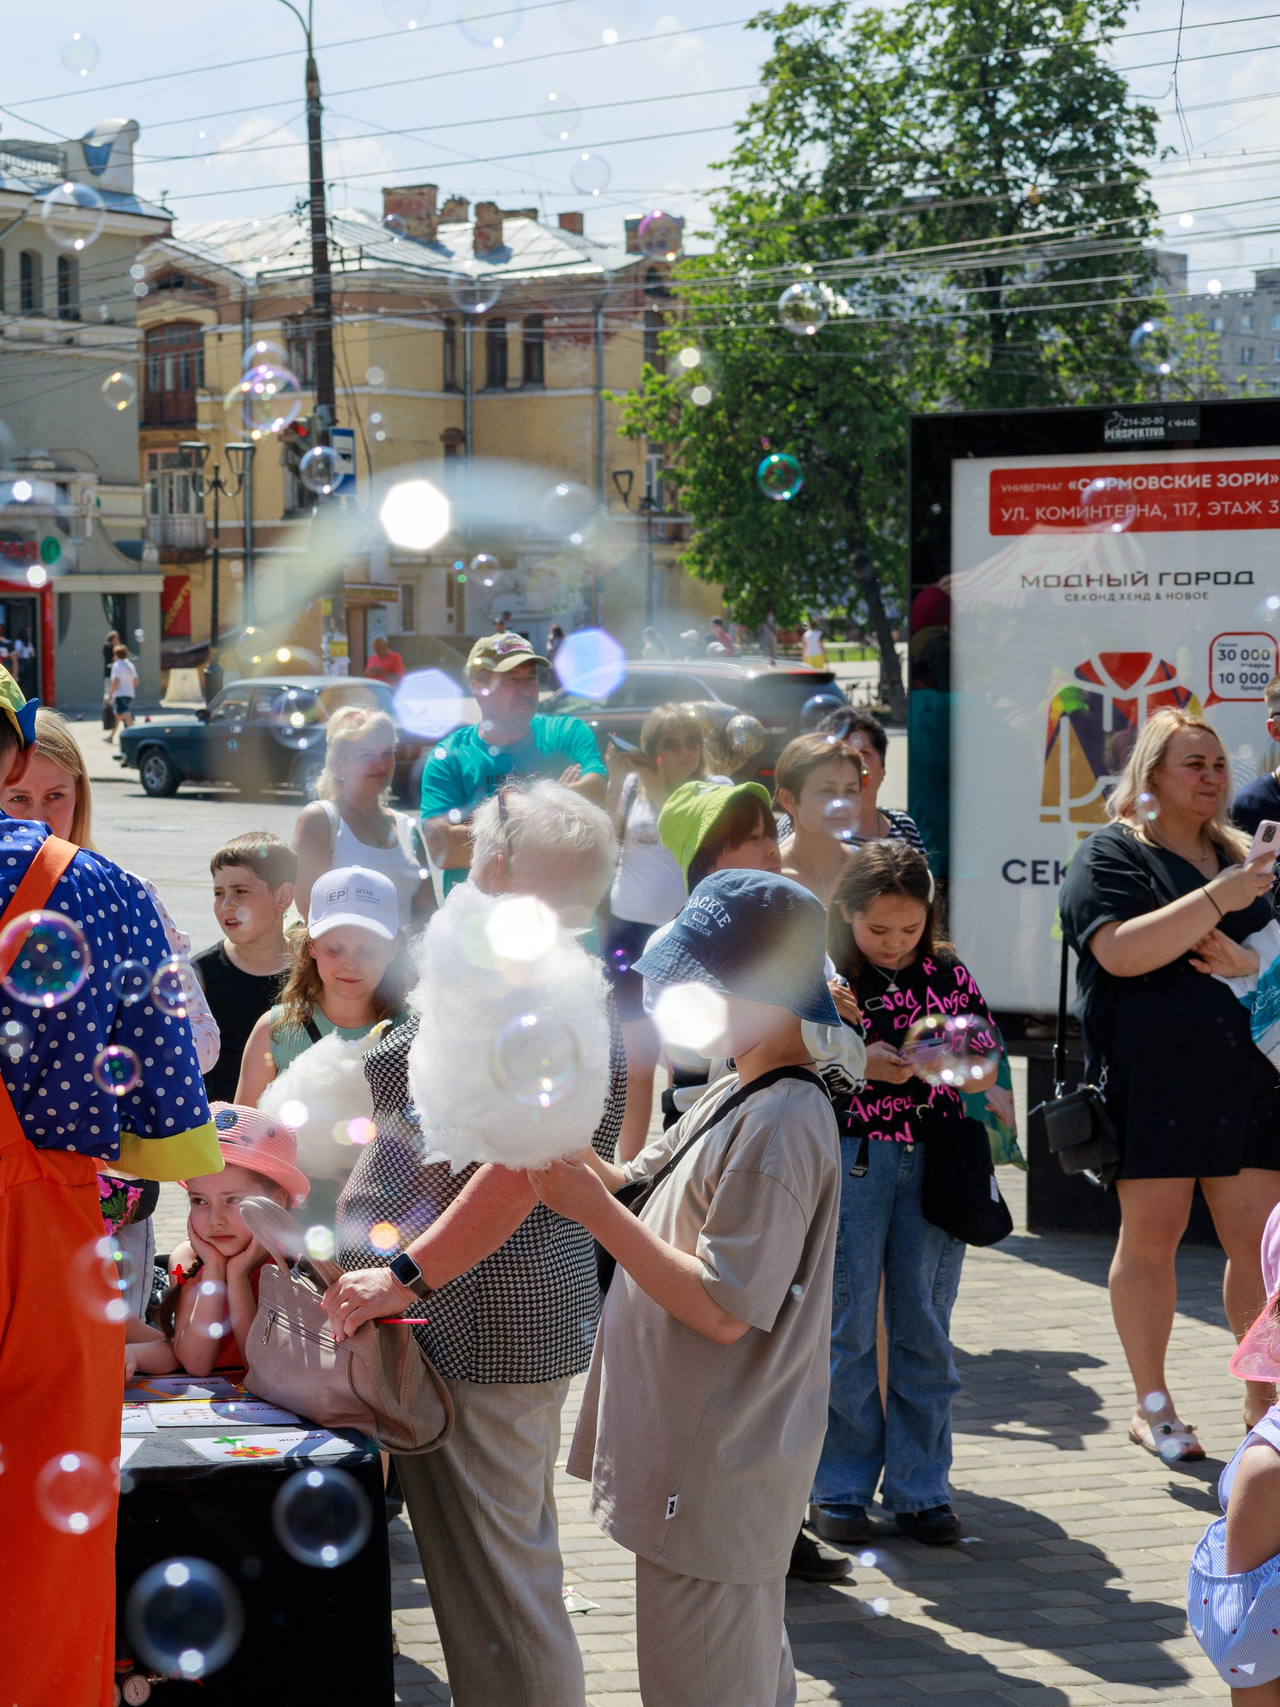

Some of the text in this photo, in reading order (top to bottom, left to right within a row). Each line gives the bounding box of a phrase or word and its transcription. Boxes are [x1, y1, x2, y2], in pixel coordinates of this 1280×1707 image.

[1122, 416, 1165, 427] 214-20-80
[1104, 427, 1165, 440] PERSPEKTIVA
[1001, 472, 1279, 493] УНИВЕРМАГ «СОРМОВСКИЕ ЗОРИ»
[1000, 499, 1280, 521] УЛ. КОМИНТЕРНА, 117, ЭТАЖ 3
[1021, 570, 1255, 588] МОДНЫЙ ГОРОД
[1064, 592, 1115, 602] СЕКОНД
[1120, 592, 1151, 602] ХЕНД
[1166, 591, 1209, 601] НОВОЕ
[1218, 649, 1271, 661] 30 000
[1219, 672, 1270, 685] 10 000
[1002, 859, 1067, 886] СЕК
[355, 887, 374, 897] ШТАБ
[685, 895, 732, 929] JACKIE
